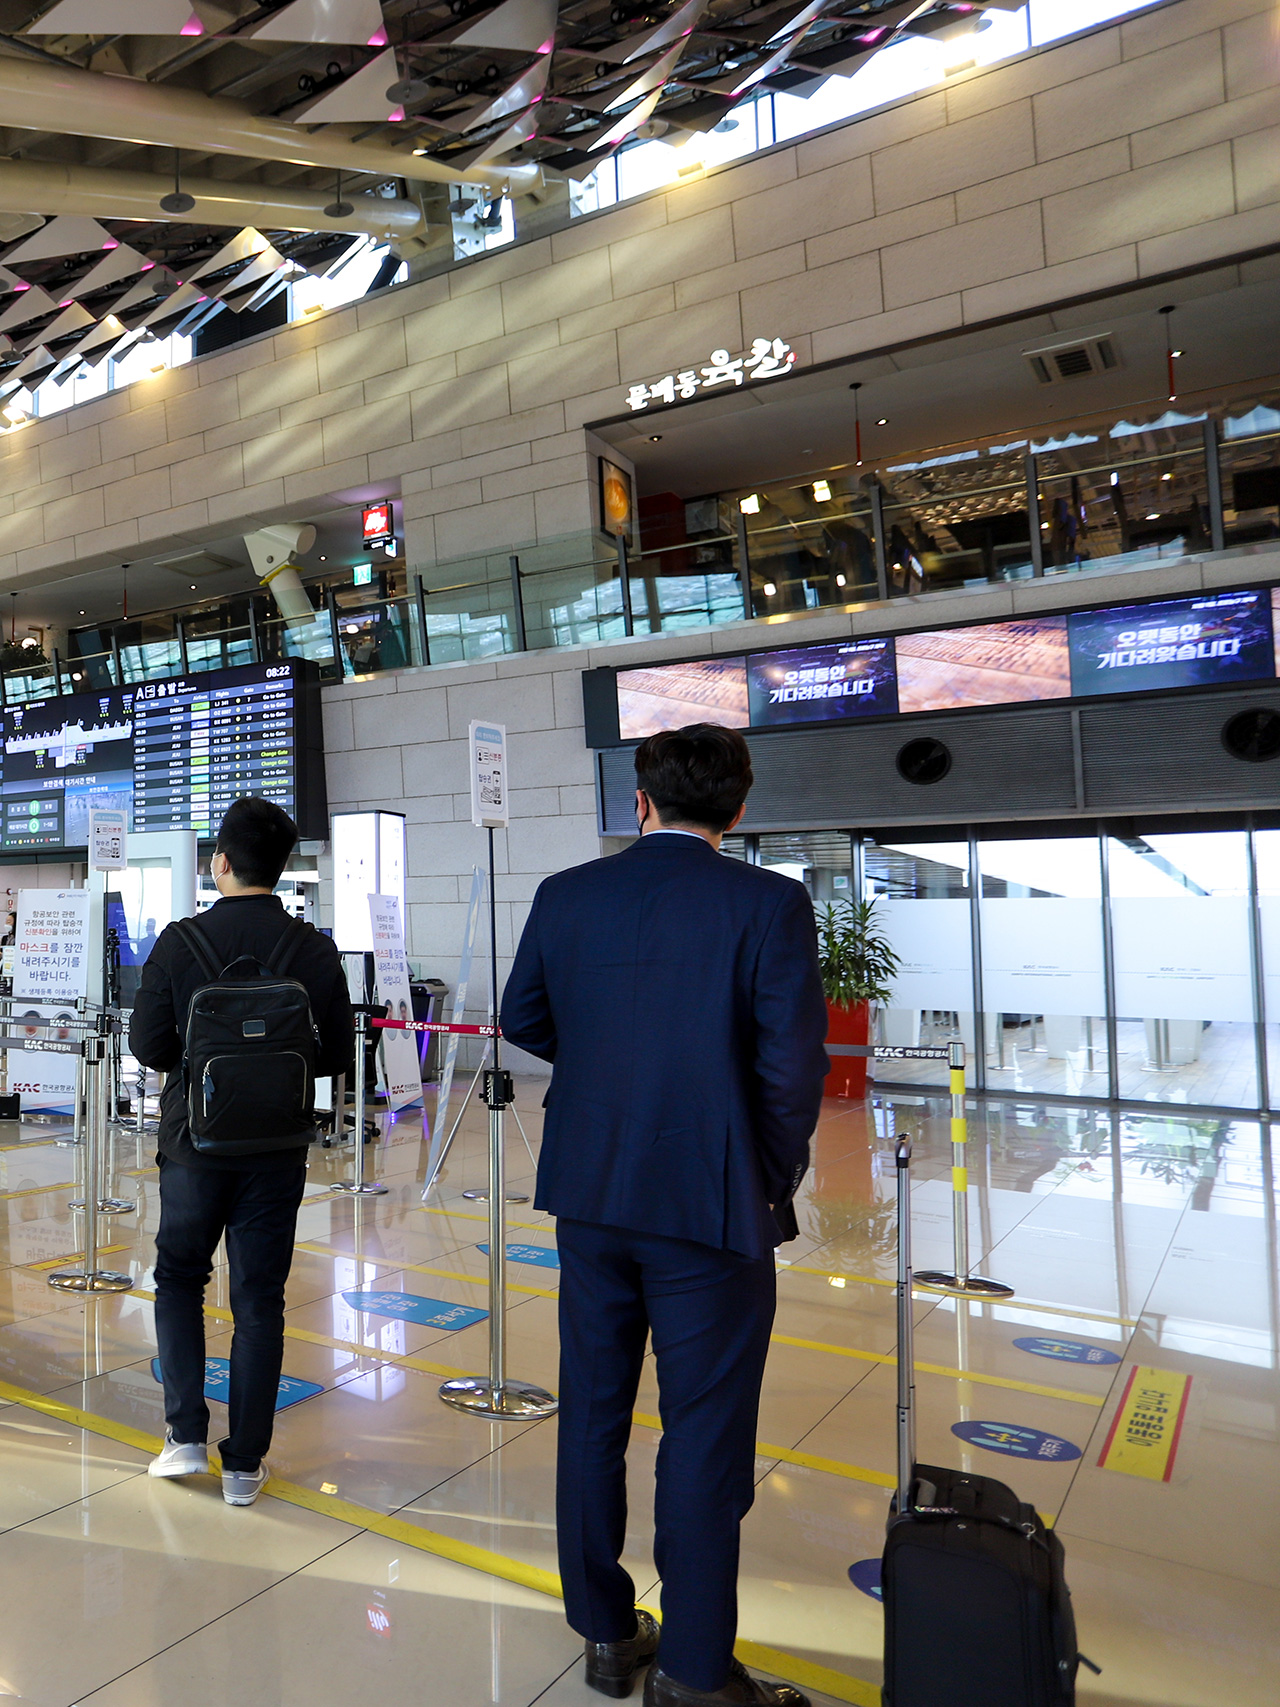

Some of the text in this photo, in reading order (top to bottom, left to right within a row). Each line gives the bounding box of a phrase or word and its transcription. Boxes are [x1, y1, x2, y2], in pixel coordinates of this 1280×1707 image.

[1116, 623, 1202, 649] 오랫동안
[1096, 639, 1243, 670] 기다려왔습니다
[266, 665, 290, 678] 08:22
[784, 664, 848, 687] 오랫동안
[136, 687, 144, 700] A
[768, 678, 875, 704] 기다려왔습니다
[32, 911, 76, 919] 항공보안 관련
[24, 919, 83, 928] 규정에 따라 탑승객
[24, 928, 82, 936] 신분확인을 위하여
[20, 942, 83, 954] 마스크를 잠깐
[21, 957, 80, 968] 내려주시기를
[29, 971, 71, 982] 바랍니다.
[50, 1019, 65, 1027] KAC
[405, 1021, 423, 1030] KAC
[24, 1040, 71, 1051] KAC 한국공항공사
[874, 1047, 949, 1058] KAC 한국공항공사
[14, 1083, 40, 1093] KAC
